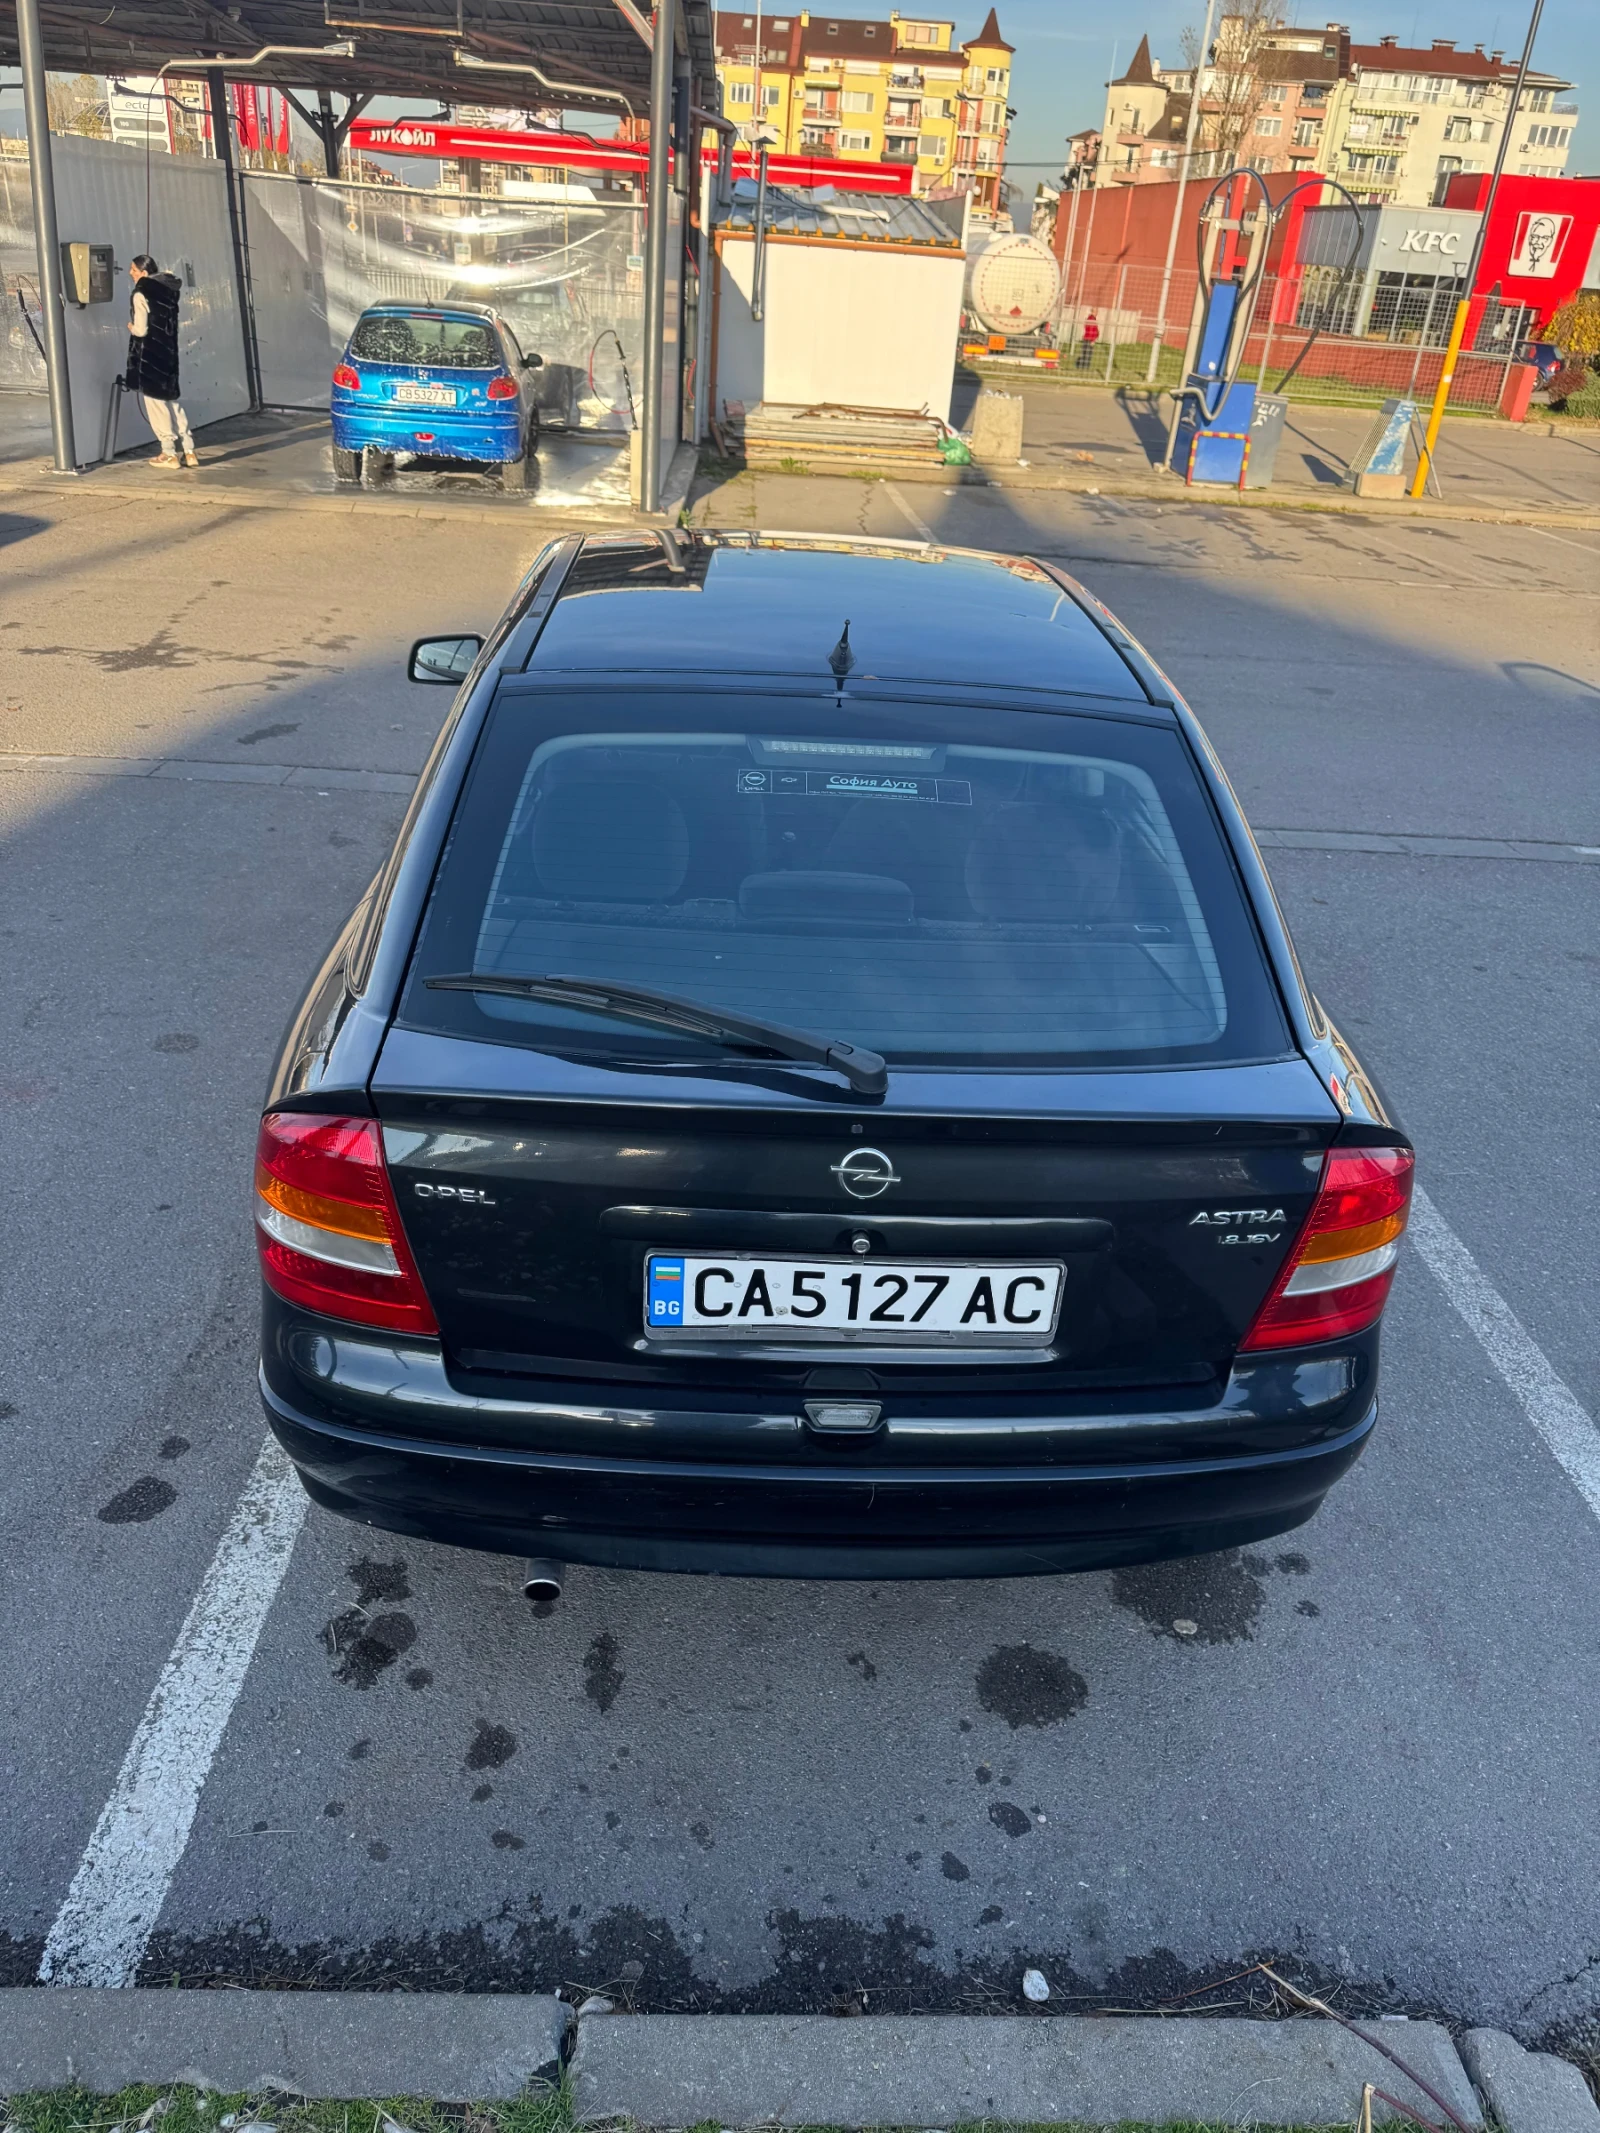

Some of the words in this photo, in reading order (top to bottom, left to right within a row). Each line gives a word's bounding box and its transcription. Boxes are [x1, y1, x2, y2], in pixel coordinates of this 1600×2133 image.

[369, 128, 436, 147] ЛУКОЙЛ
[1399, 229, 1461, 255] KFC
[414, 389, 439, 401] 5327
[441, 391, 454, 402] XT
[829, 775, 877, 787] София
[881, 778, 918, 789] Ауто
[414, 1183, 496, 1205] OPEL
[1188, 1209, 1287, 1225] ASTRA
[693, 1266, 774, 1318] CA
[790, 1270, 950, 1324] 5127
[959, 1275, 1046, 1325] AC
[653, 1300, 680, 1316] BG
